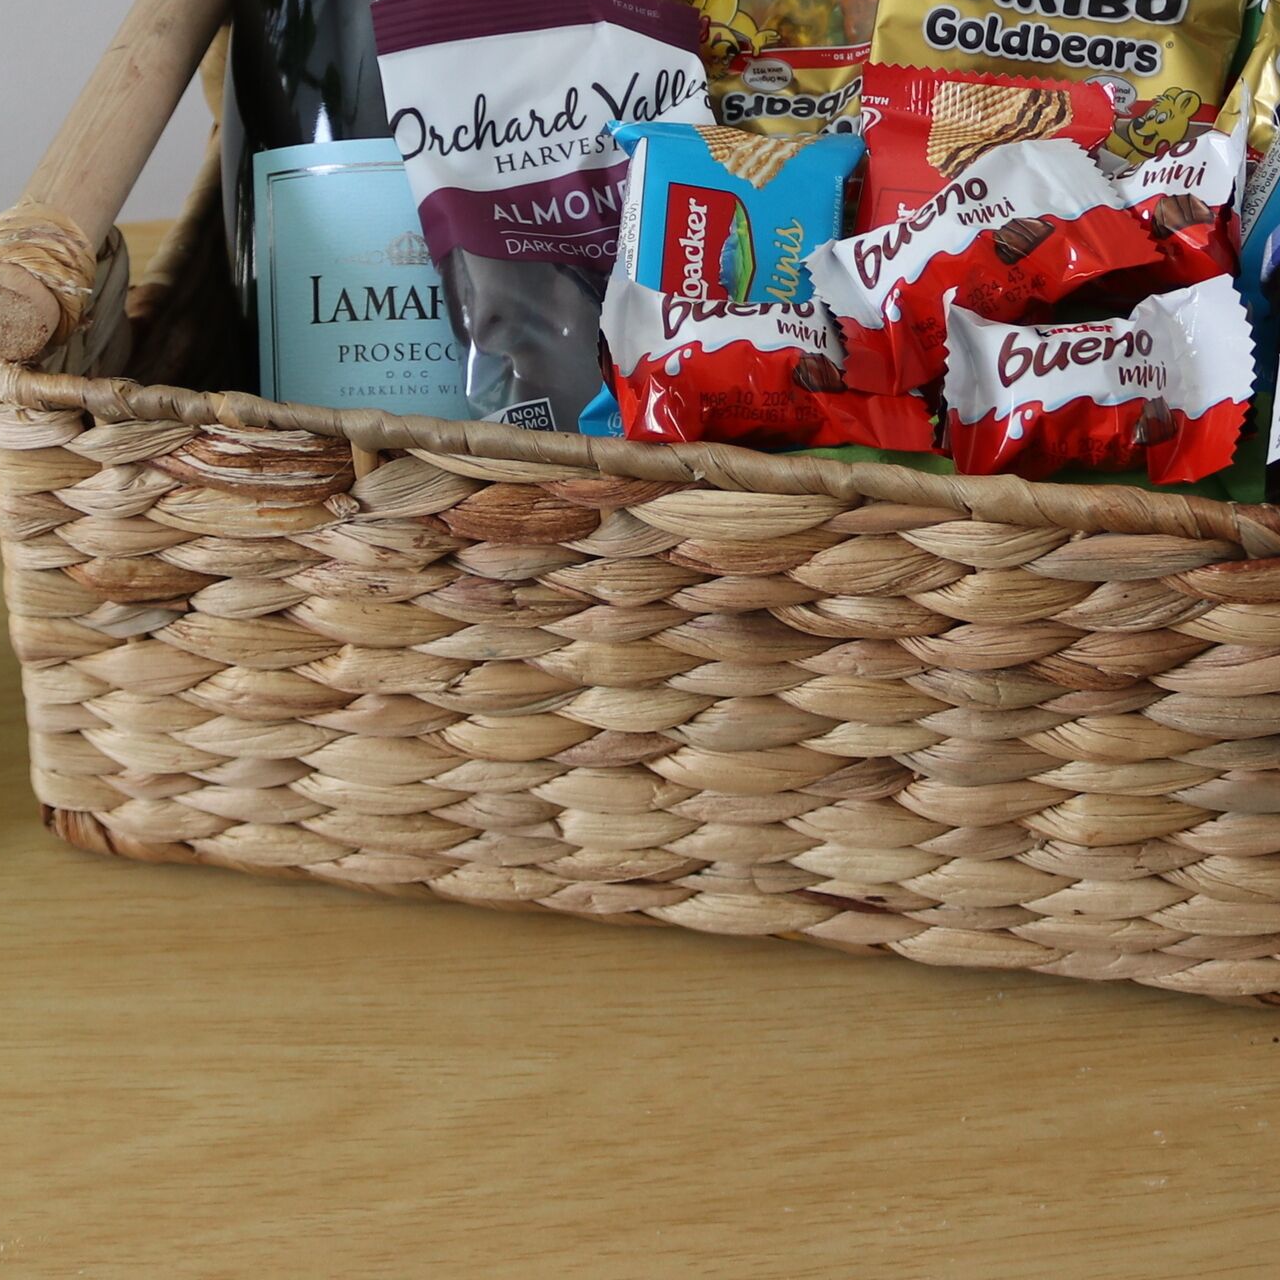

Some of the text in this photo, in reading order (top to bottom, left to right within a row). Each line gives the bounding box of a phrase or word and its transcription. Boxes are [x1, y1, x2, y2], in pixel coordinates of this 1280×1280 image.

[854, 48, 870, 59] ove
[924, 6, 1160, 74] Goldbears
[723, 77, 864, 121] dbears
[860, 95, 891, 106] HALA
[388, 86, 588, 162] Orchard
[1141, 160, 1208, 190] mini
[493, 180, 628, 226] ALMON
[956, 196, 1016, 227] mini
[831, 211, 841, 240] REAM
[853, 176, 989, 290] bueno
[505, 237, 558, 256] DARK
[674, 197, 709, 304] Loacker
[309, 274, 445, 325] LAMA
[776, 318, 828, 350] mini
[337, 341, 458, 364] PROSECC
[997, 328, 1154, 389] bueno
[1118, 359, 1167, 391] mini
[339, 384, 458, 398] SPARKLING WI
[511, 404, 547, 421] NON
[516, 416, 550, 430] GMO
